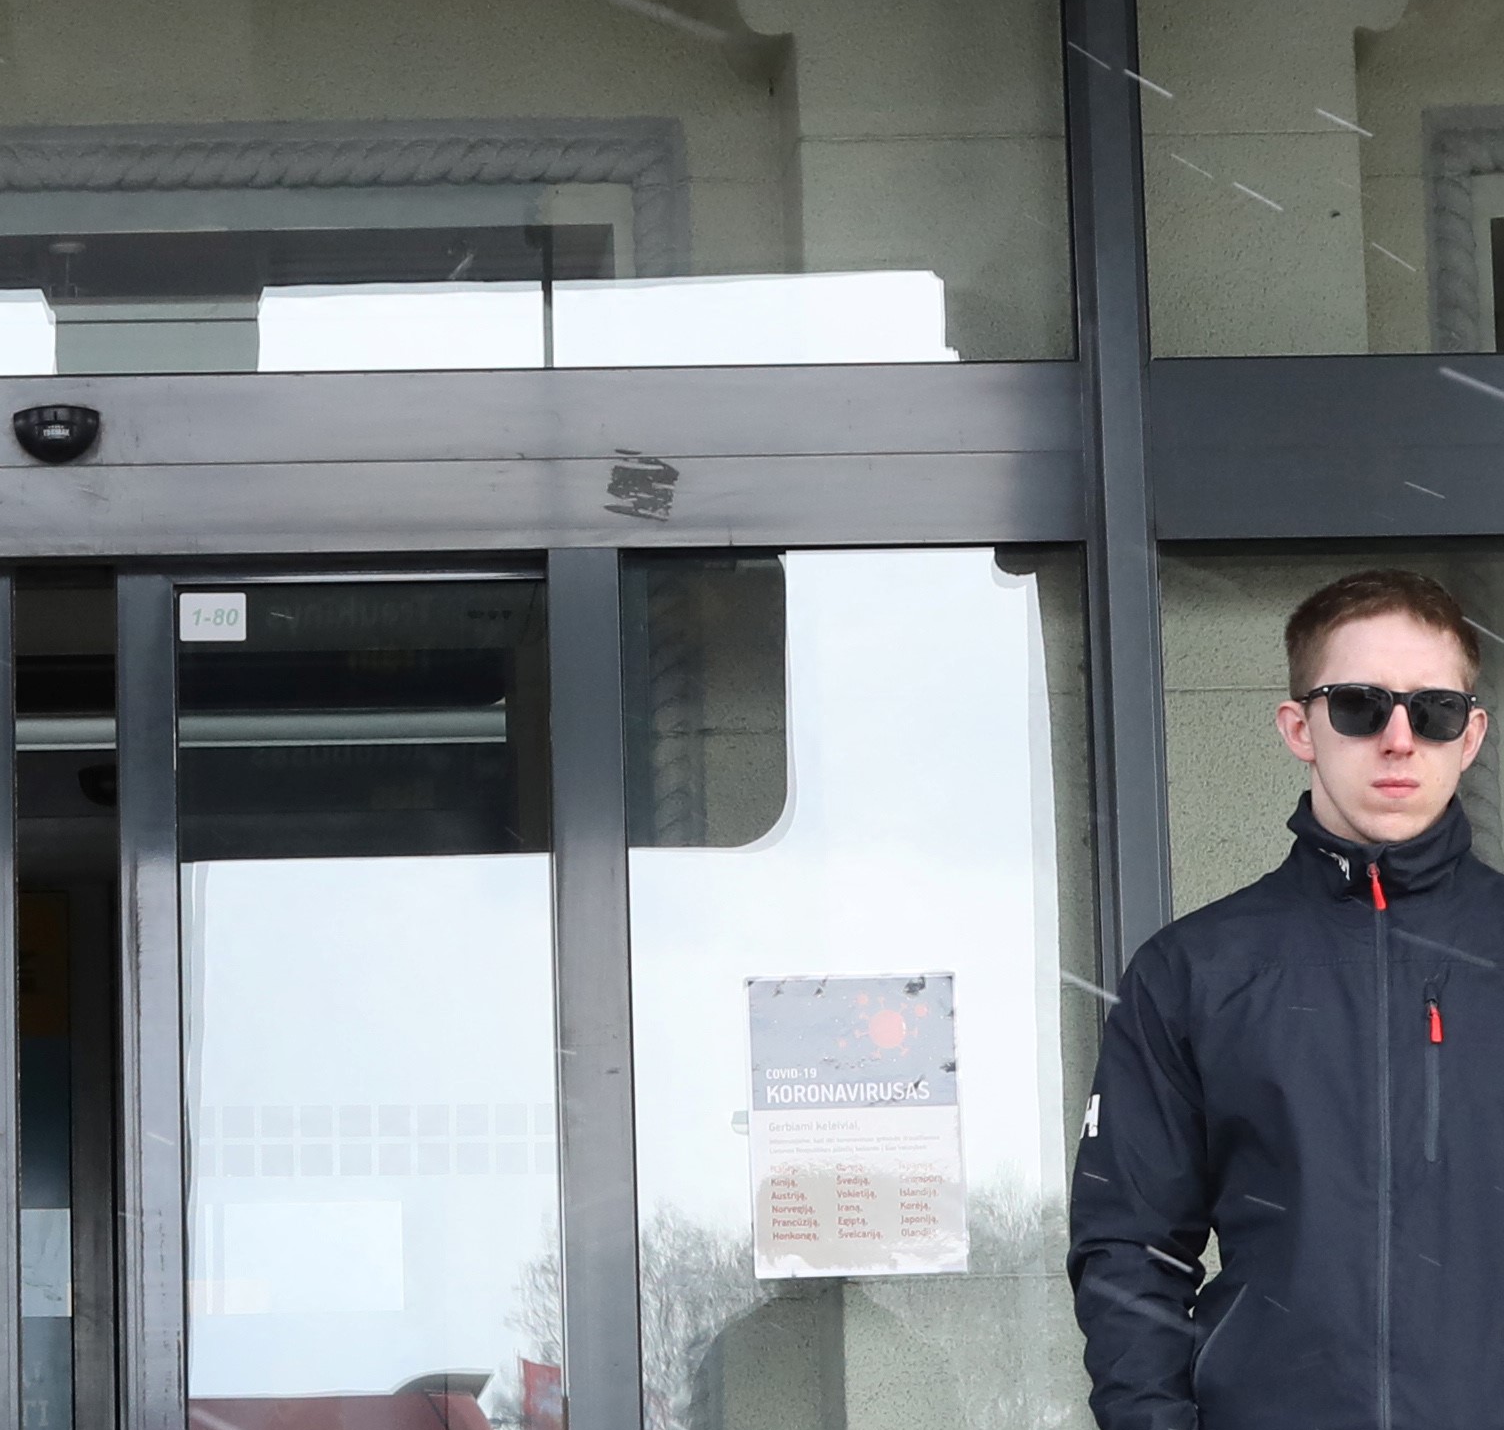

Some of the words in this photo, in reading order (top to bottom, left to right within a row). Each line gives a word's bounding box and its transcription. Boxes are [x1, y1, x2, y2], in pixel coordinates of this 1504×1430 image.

[192, 608, 239, 626] 1-80
[766, 1069, 817, 1080] COVID-19
[766, 1082, 930, 1104] KORONAVIRUSAS
